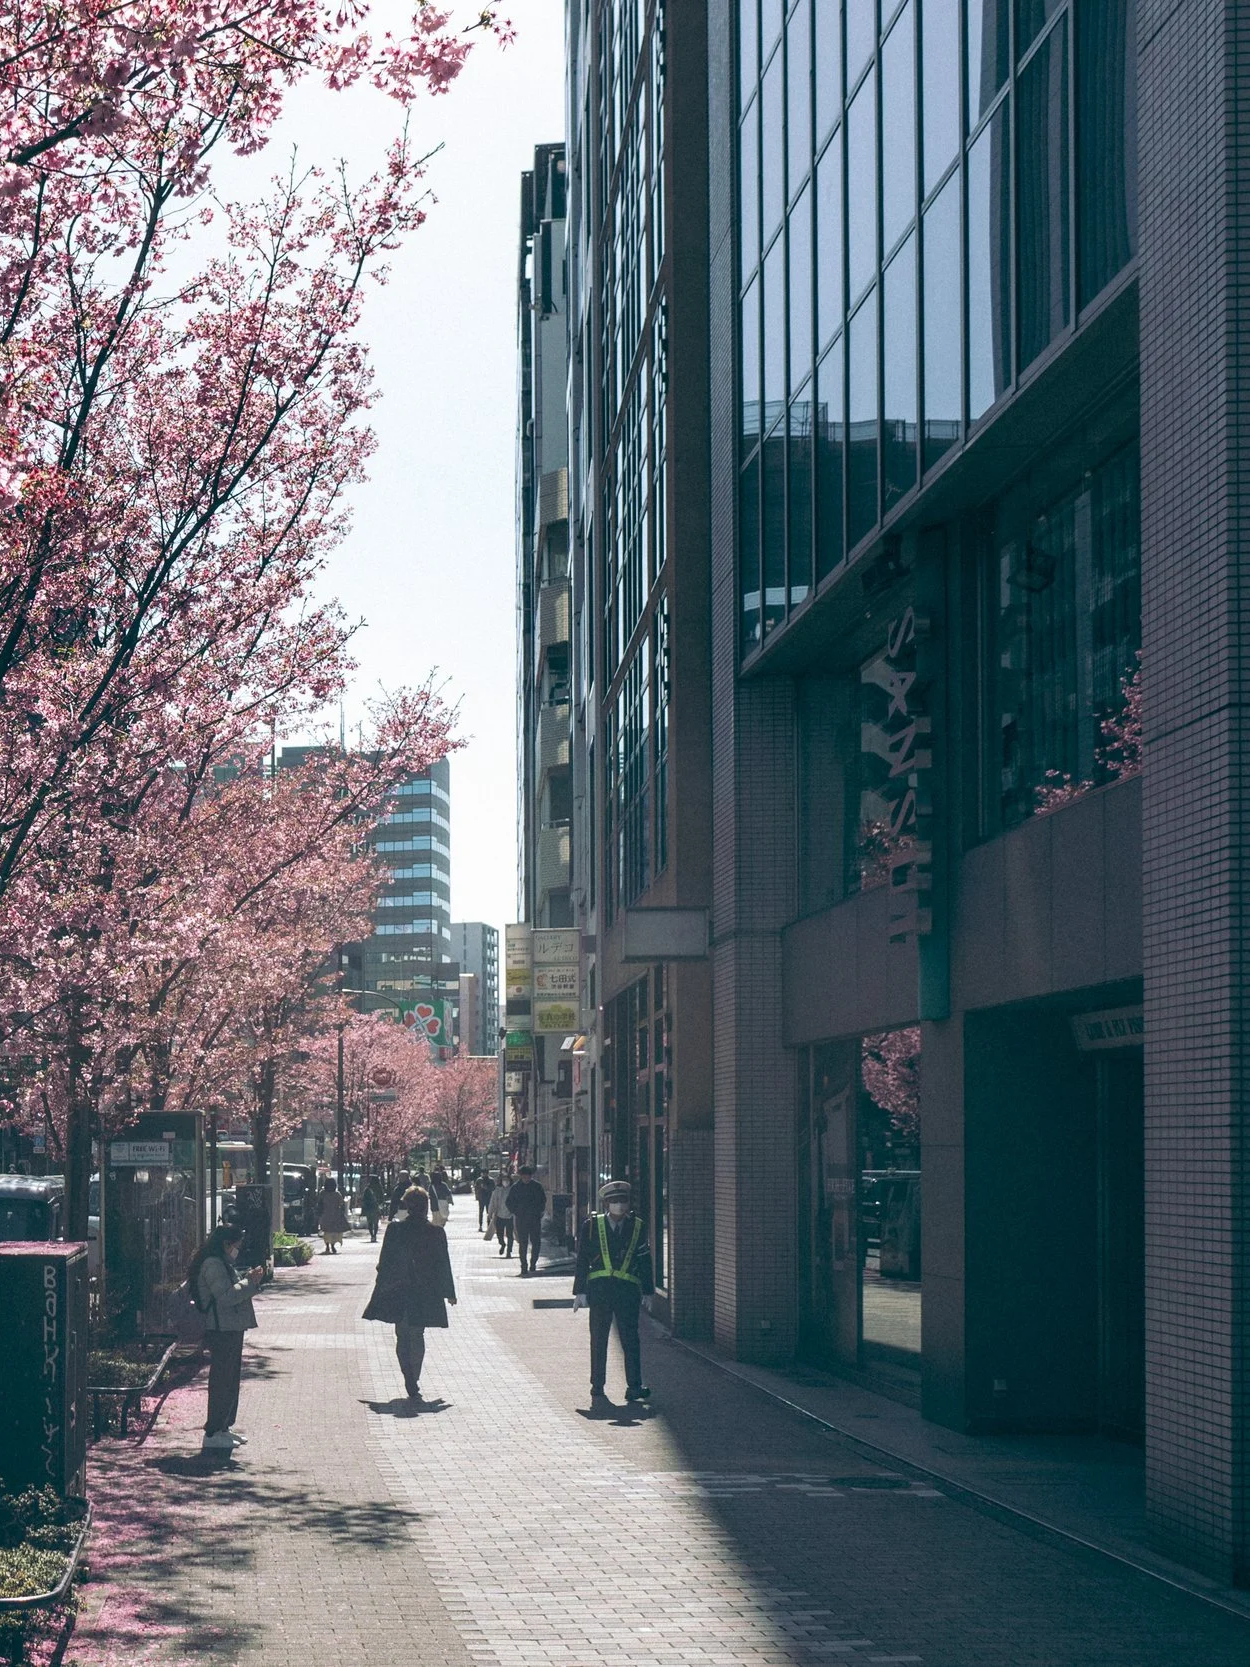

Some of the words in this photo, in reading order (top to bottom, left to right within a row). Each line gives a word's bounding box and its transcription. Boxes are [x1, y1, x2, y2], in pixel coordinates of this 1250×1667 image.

[538, 941, 574, 954] ルデコ
[549, 973, 577, 983] 七田式
